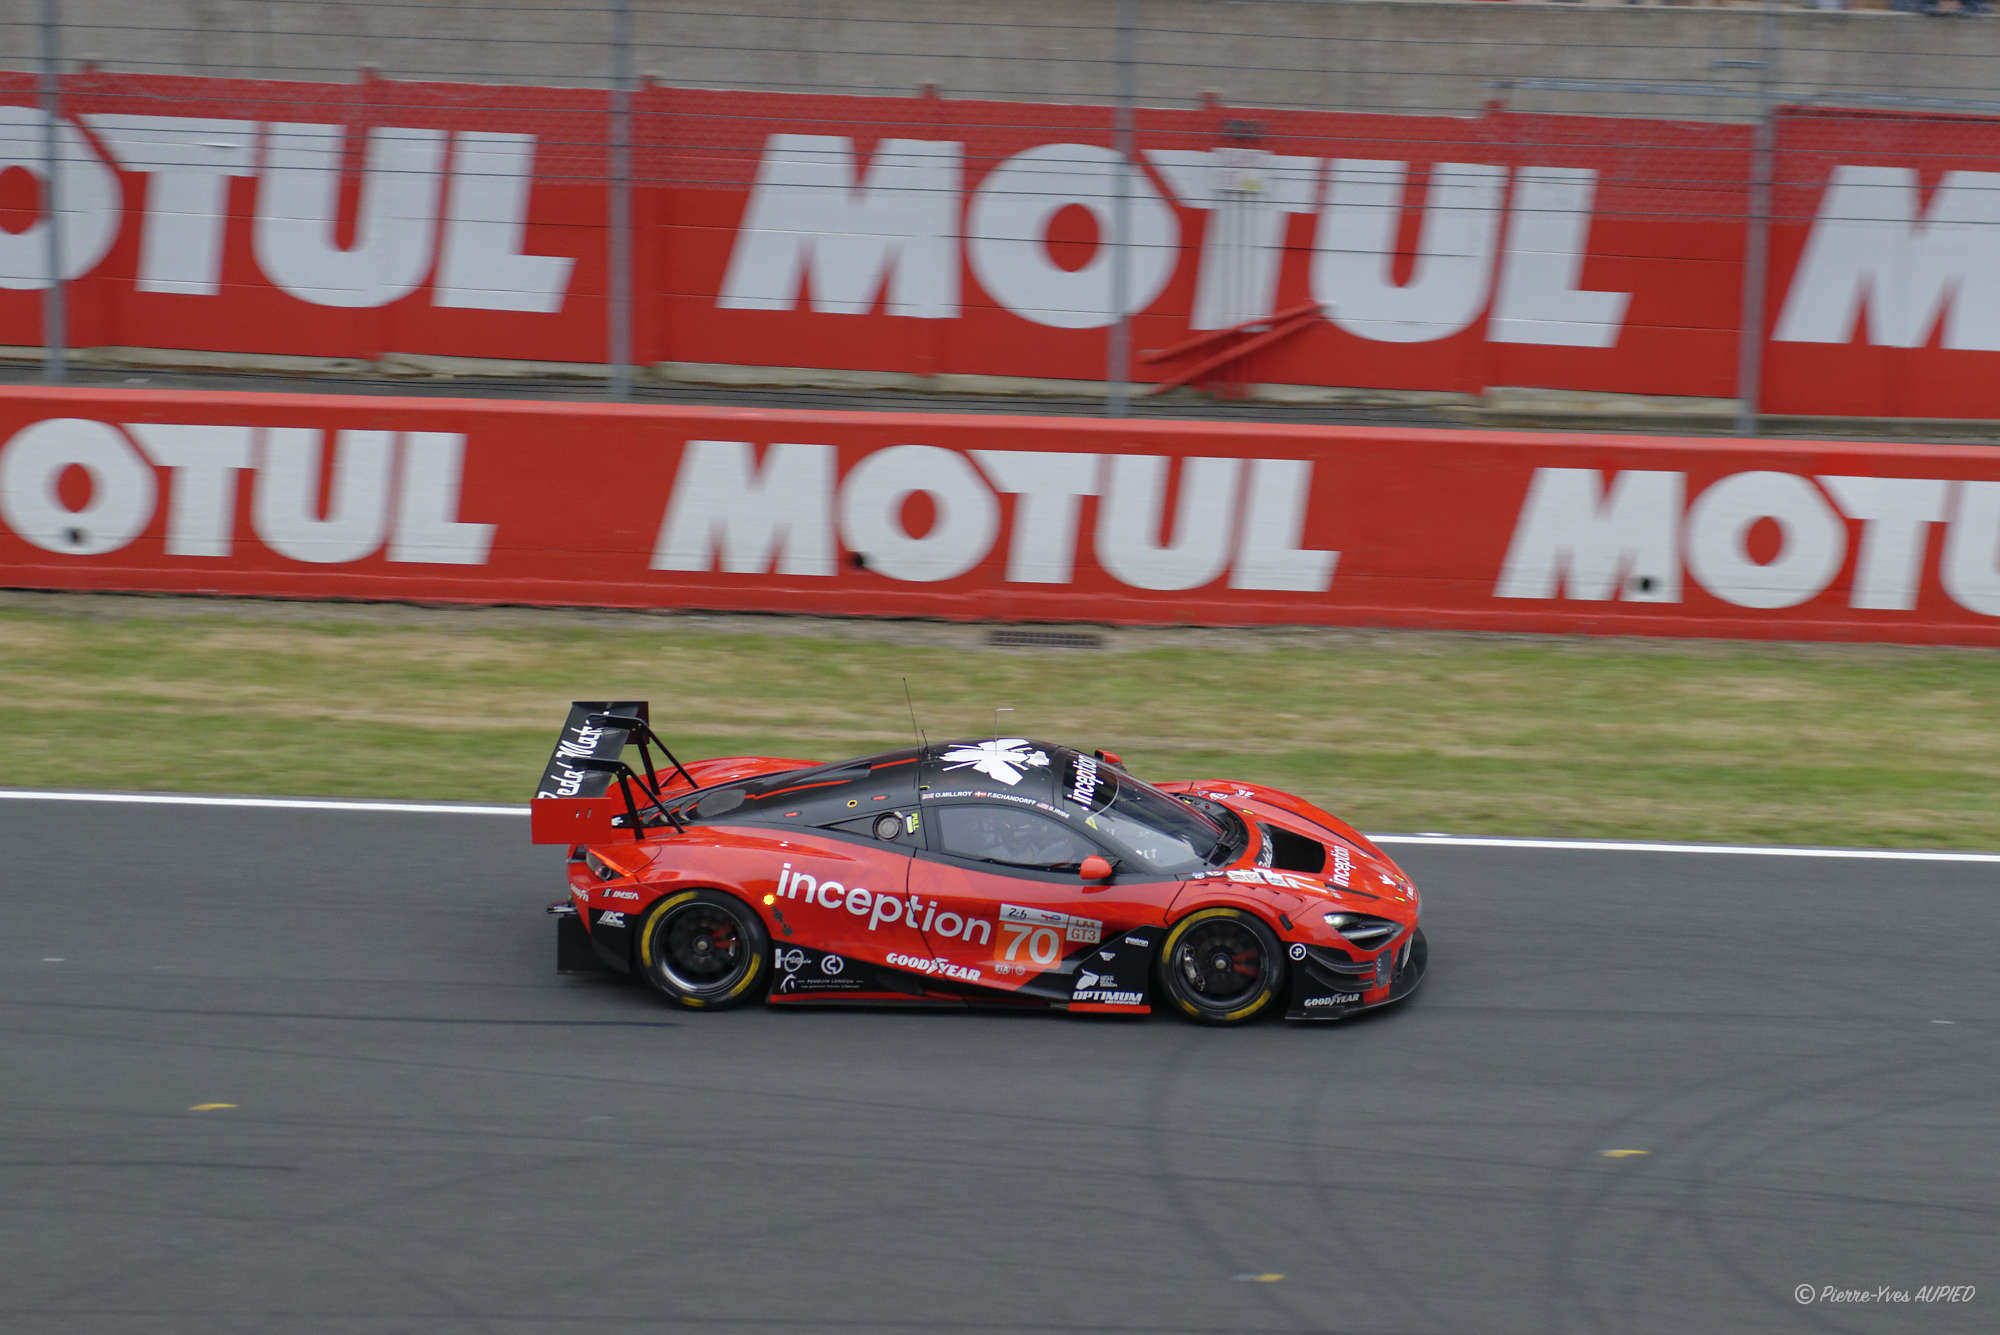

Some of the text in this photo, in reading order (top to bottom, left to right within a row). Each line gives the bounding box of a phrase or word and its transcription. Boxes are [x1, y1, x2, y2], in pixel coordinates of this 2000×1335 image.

[715, 133, 1633, 348] MOTUL
[649, 440, 1341, 592] MOTUL
[776, 862, 992, 945] inception
[1003, 923, 1059, 965] 70
[1071, 928, 1097, 941] GT3
[886, 952, 981, 982] GOODYEAR
[1072, 991, 1143, 1002] OPTIMUM
